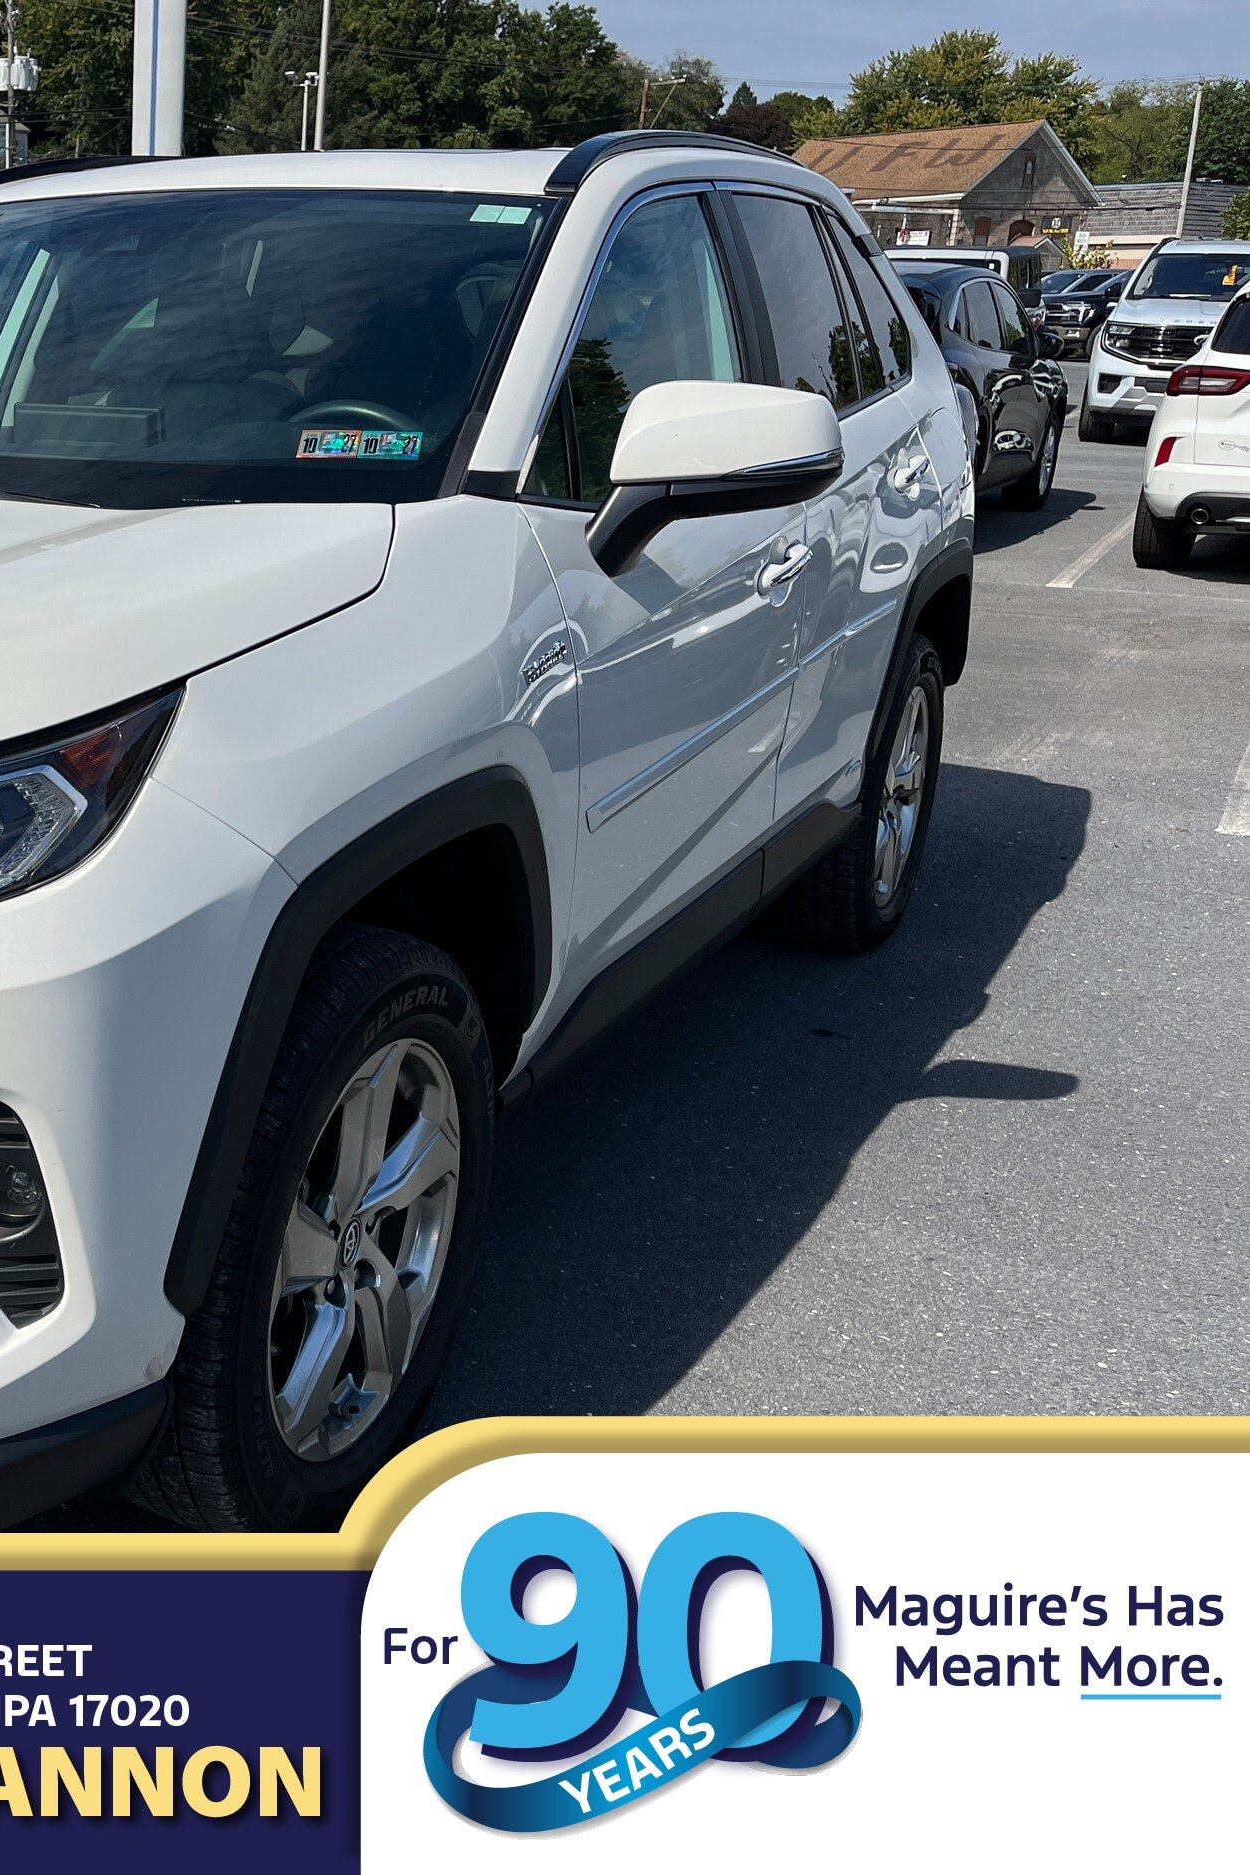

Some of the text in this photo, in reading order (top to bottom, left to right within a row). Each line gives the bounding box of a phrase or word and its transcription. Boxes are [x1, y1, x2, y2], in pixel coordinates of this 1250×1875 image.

[303, 433, 358, 454] 10 27
[363, 435, 419, 455] 10 27
[363, 985, 448, 1049] GENERAL
